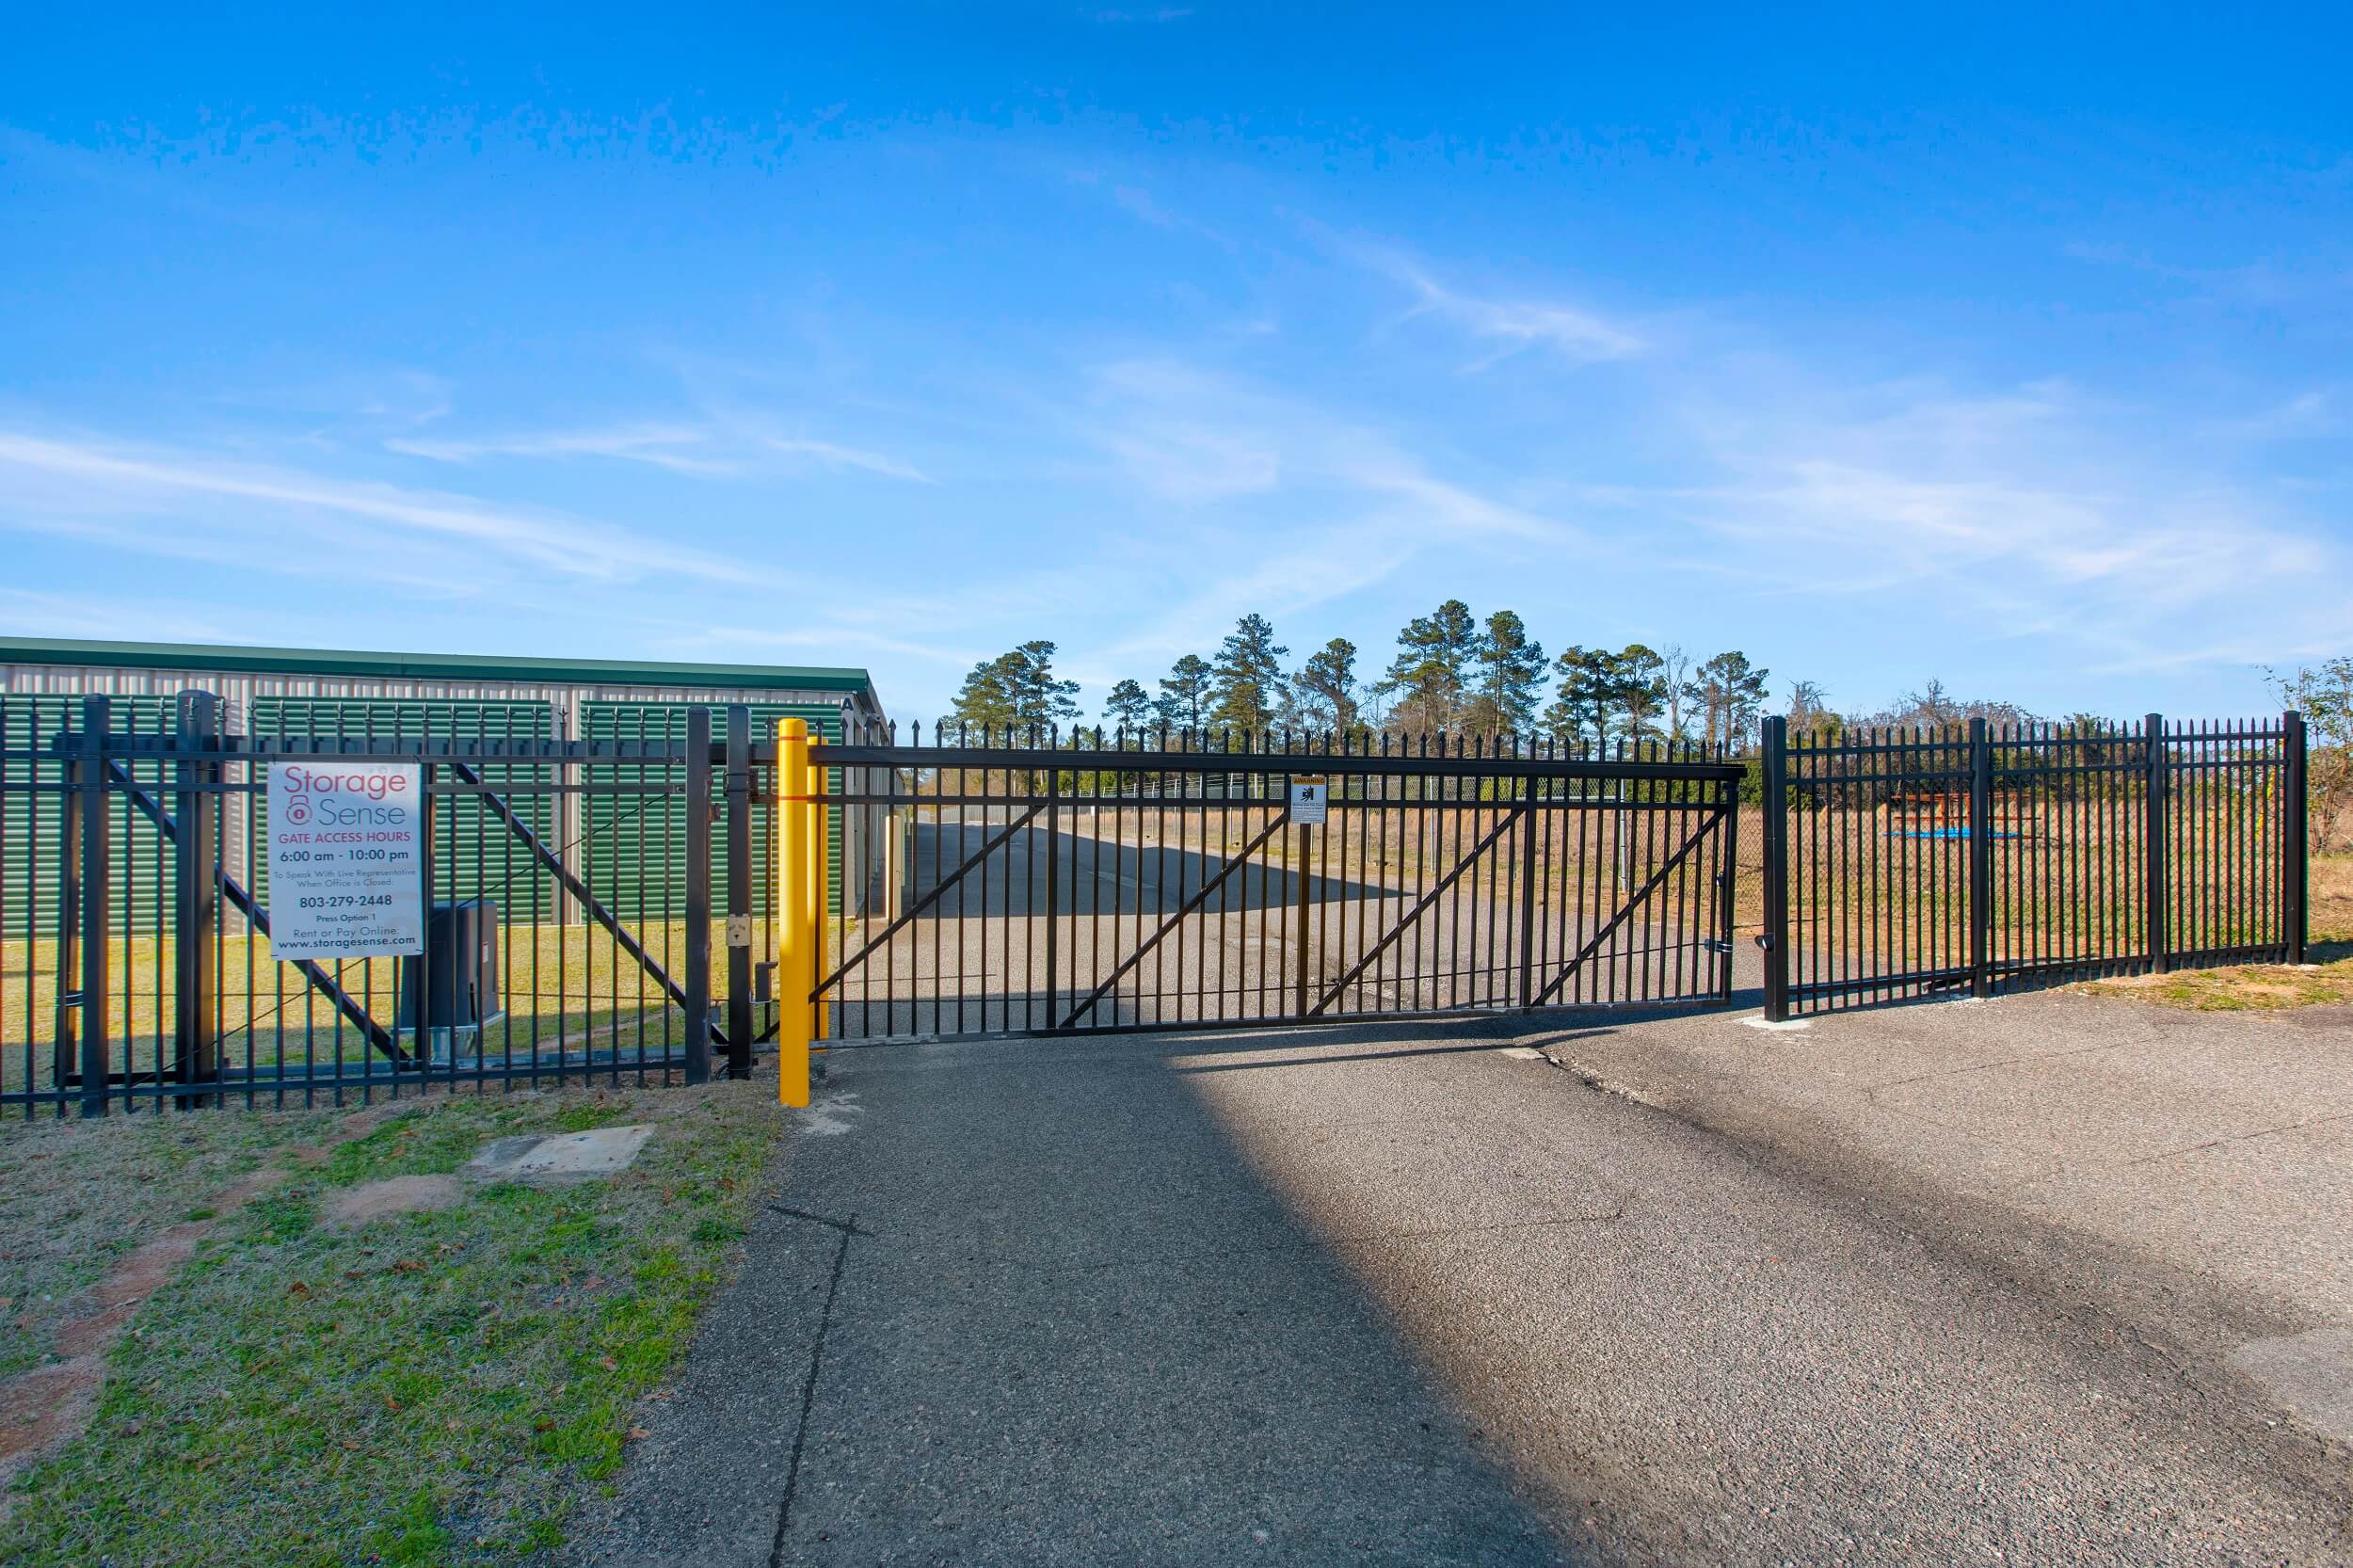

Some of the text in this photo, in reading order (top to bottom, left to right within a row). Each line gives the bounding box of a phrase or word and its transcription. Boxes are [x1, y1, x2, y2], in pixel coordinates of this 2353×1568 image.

[284, 766, 406, 800] Storage
[318, 799, 405, 825] Sense
[279, 832, 410, 843] GATE ACCESS HOURS
[280, 851, 310, 862] 6:00
[349, 850, 385, 860] 10:00
[390, 851, 408, 862] pm
[286, 872, 311, 880] Speak
[357, 869, 416, 879] Representative
[300, 895, 392, 907] 803-279-2448
[294, 930, 317, 938] Rent
[337, 928, 356, 938] Pay
[360, 926, 399, 936] Online:
[279, 936, 415, 950] www.storagesense.com
